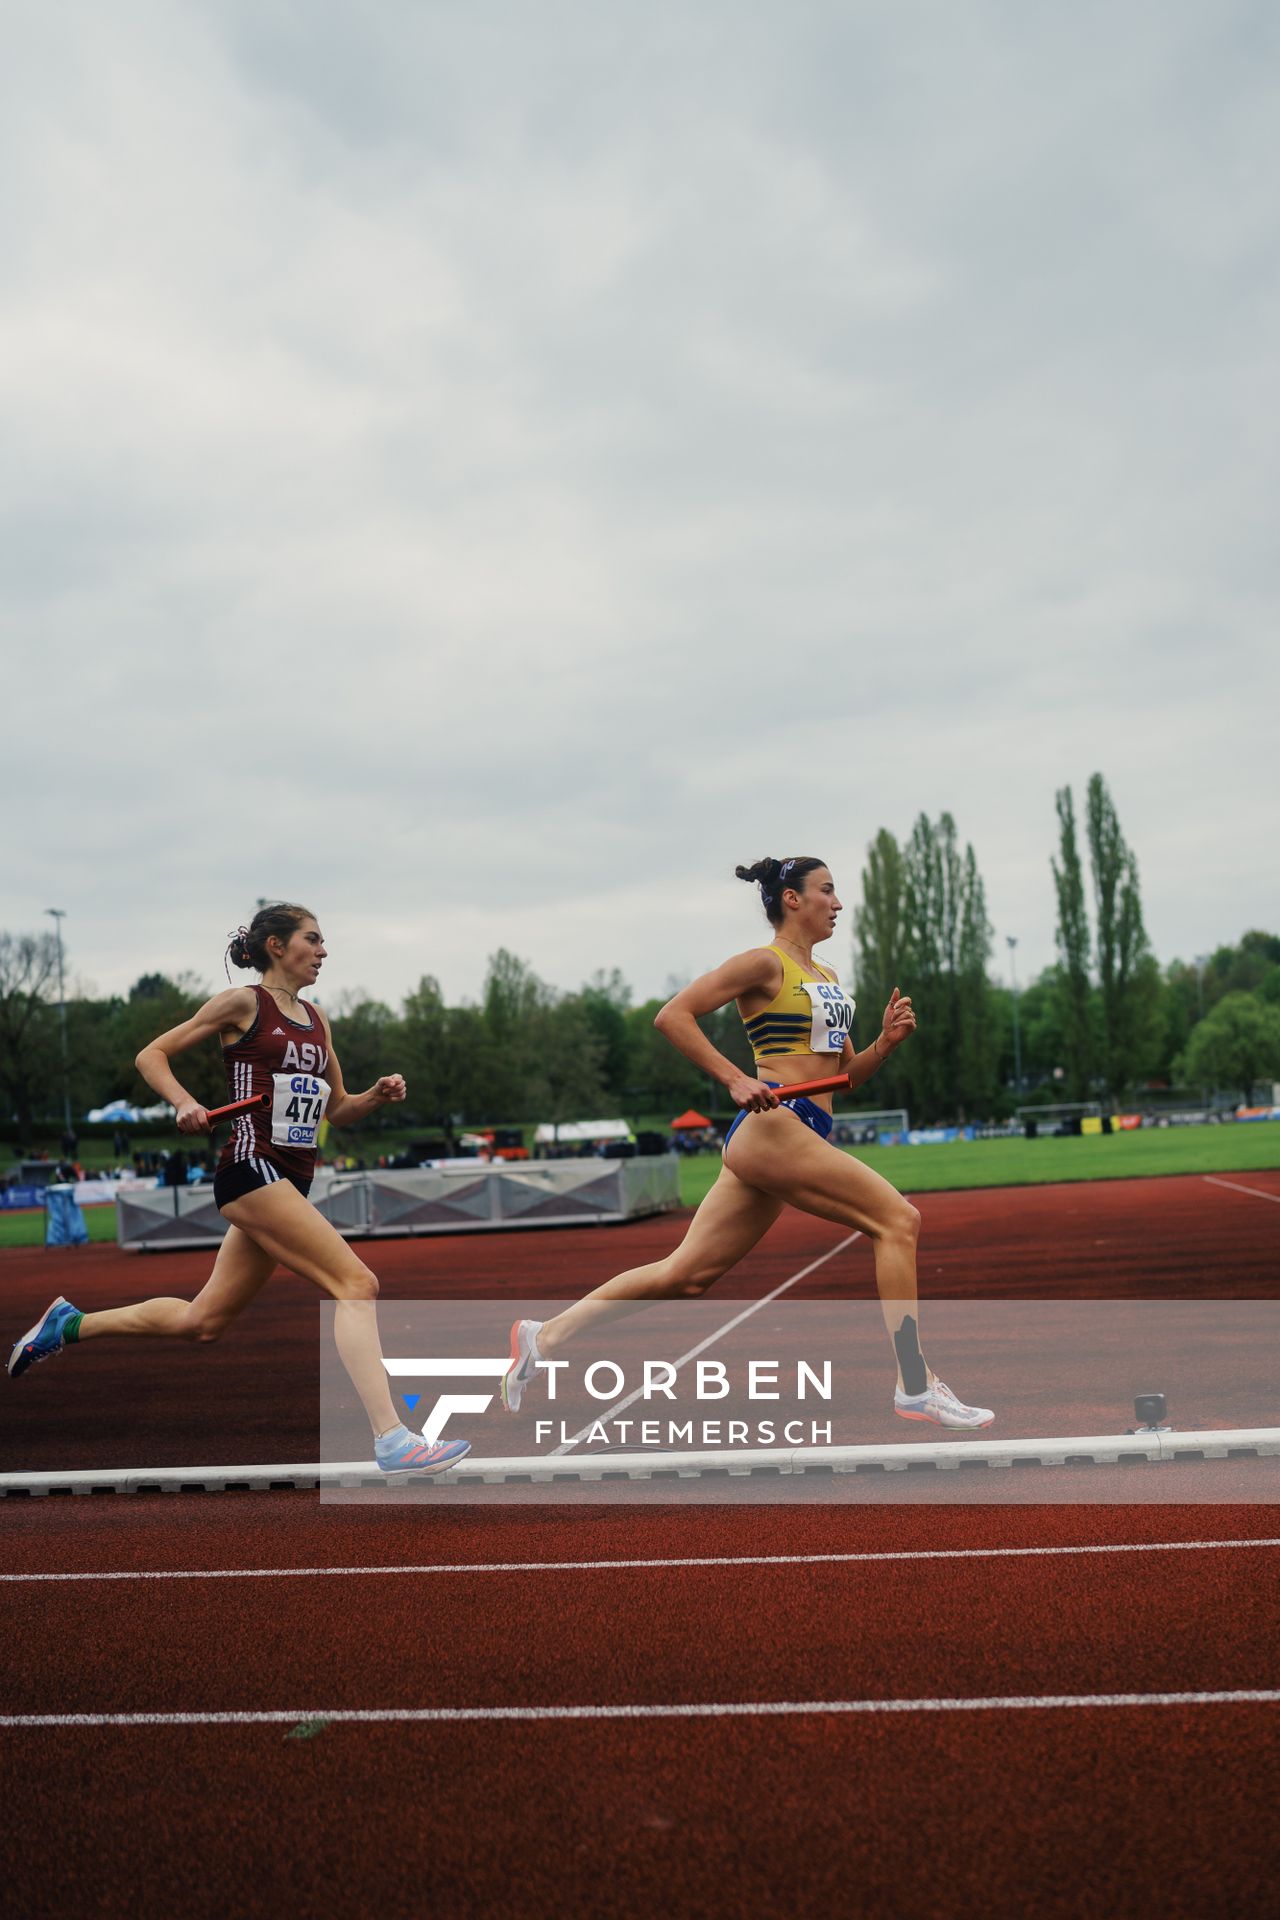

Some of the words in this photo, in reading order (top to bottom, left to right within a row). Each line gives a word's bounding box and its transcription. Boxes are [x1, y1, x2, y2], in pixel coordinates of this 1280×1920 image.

[817, 985, 844, 1001] GLS
[823, 1002, 852, 1030] 300
[281, 1040, 329, 1074] ASV
[285, 1096, 323, 1125] 474
